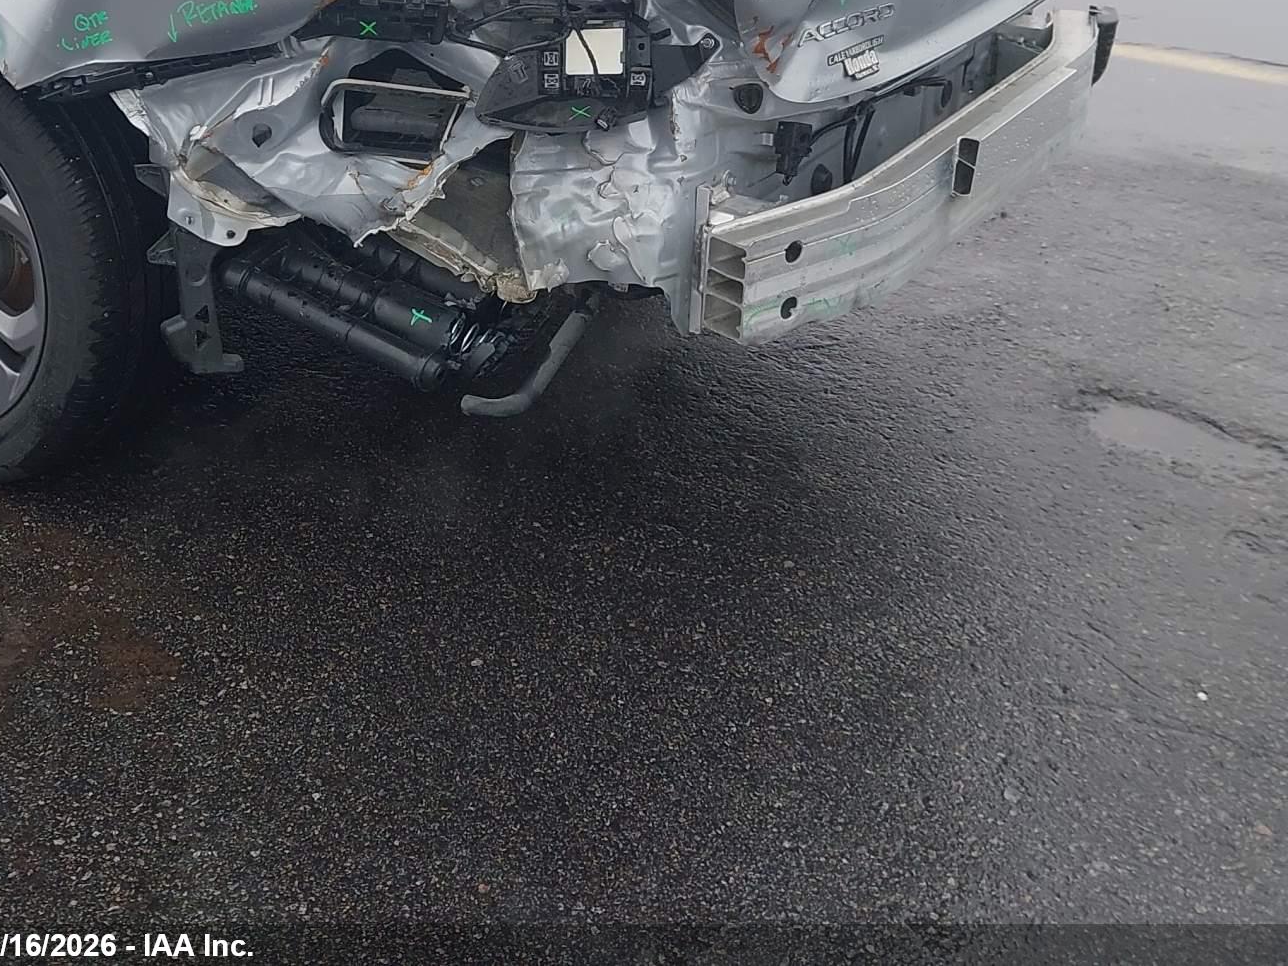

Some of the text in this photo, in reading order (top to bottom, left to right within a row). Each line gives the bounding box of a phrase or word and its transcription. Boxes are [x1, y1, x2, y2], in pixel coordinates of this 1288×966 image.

[74, 10, 109, 32] QTR
[797, 2, 895, 48] ACCORD
[843, 49, 879, 76] Honda
